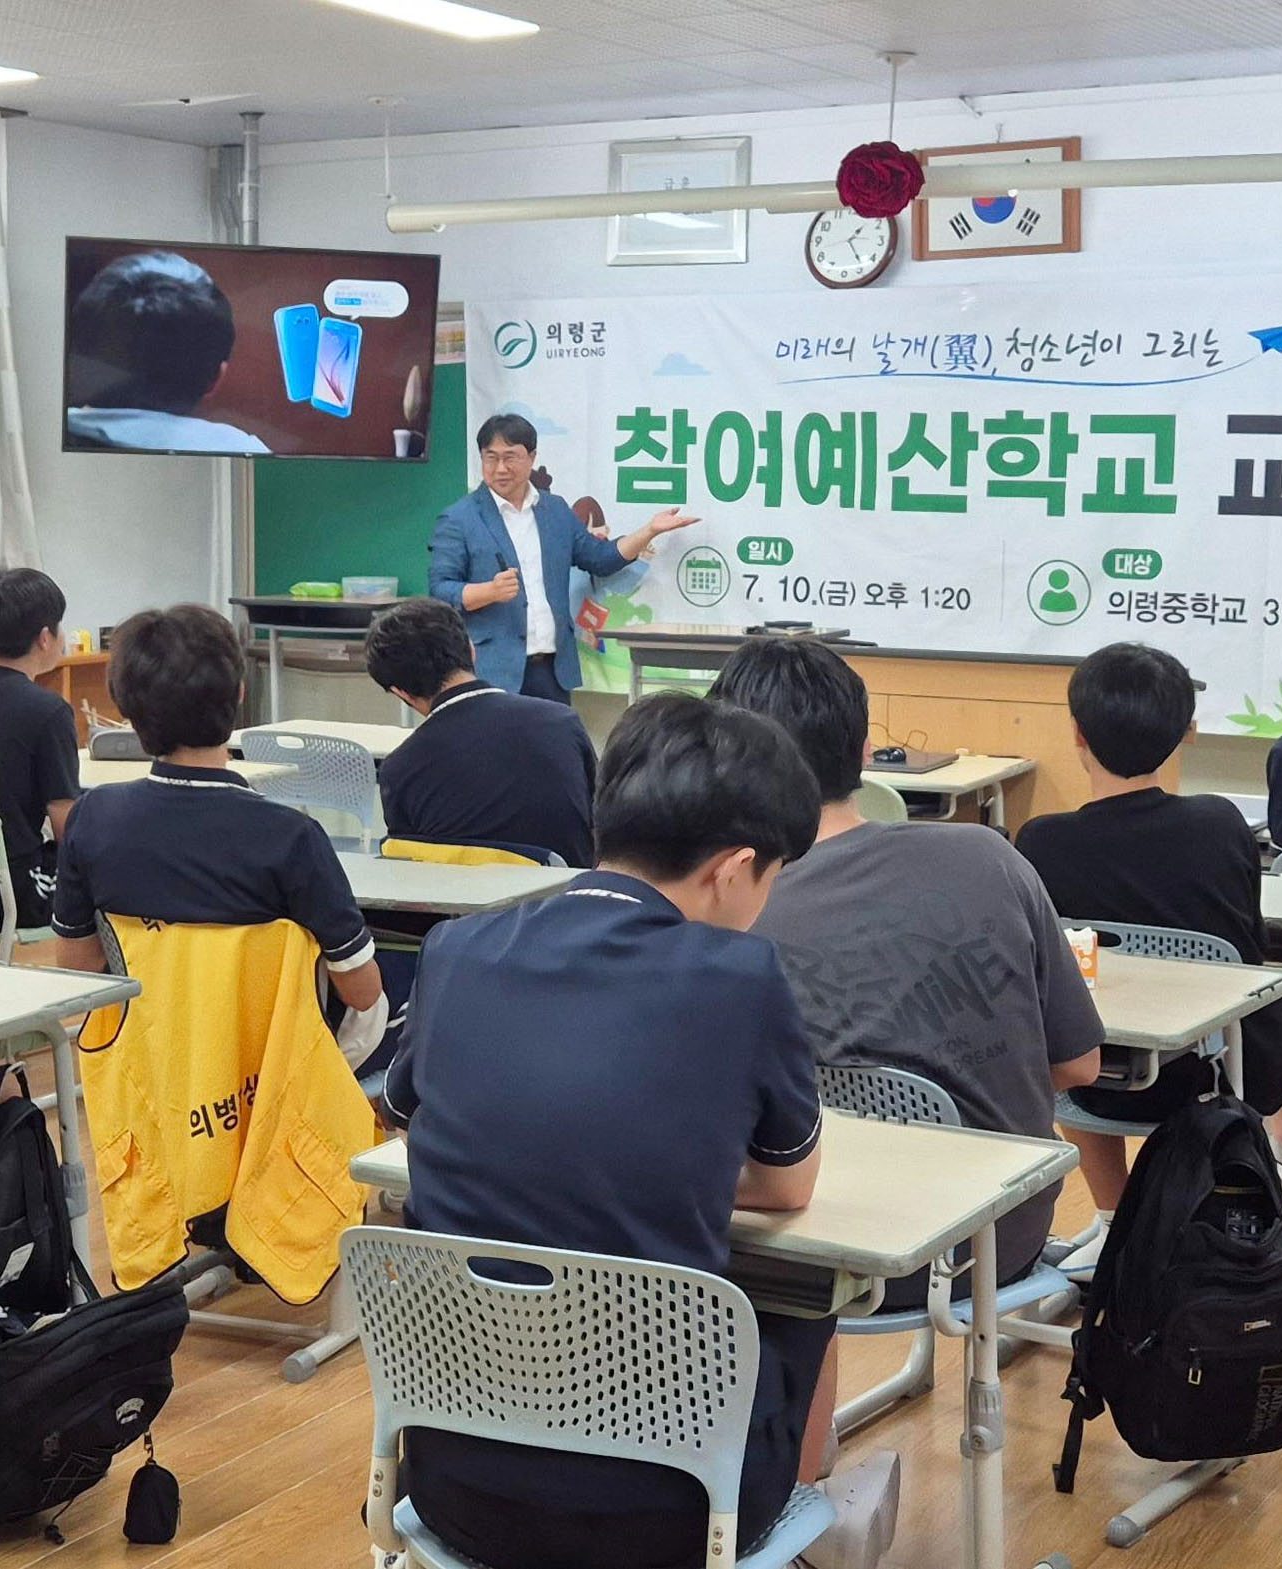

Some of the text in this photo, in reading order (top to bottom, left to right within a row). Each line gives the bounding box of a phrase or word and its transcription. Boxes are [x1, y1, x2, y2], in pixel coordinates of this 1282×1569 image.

[546, 321, 607, 345] 의령군
[546, 346, 607, 359] UIRYEONG
[775, 336, 856, 363] 미래의
[1004, 326, 1122, 373] 청소년이
[1142, 327, 1224, 368] 그리는
[613, 406, 1178, 518] 참여예산학교
[747, 540, 784, 562] 일시
[1113, 553, 1154, 576] 대상
[742, 574, 765, 603] 7.
[863, 581, 909, 610] 오후
[919, 585, 972, 611] 1:20
[1106, 589, 1249, 626] 의령중학교
